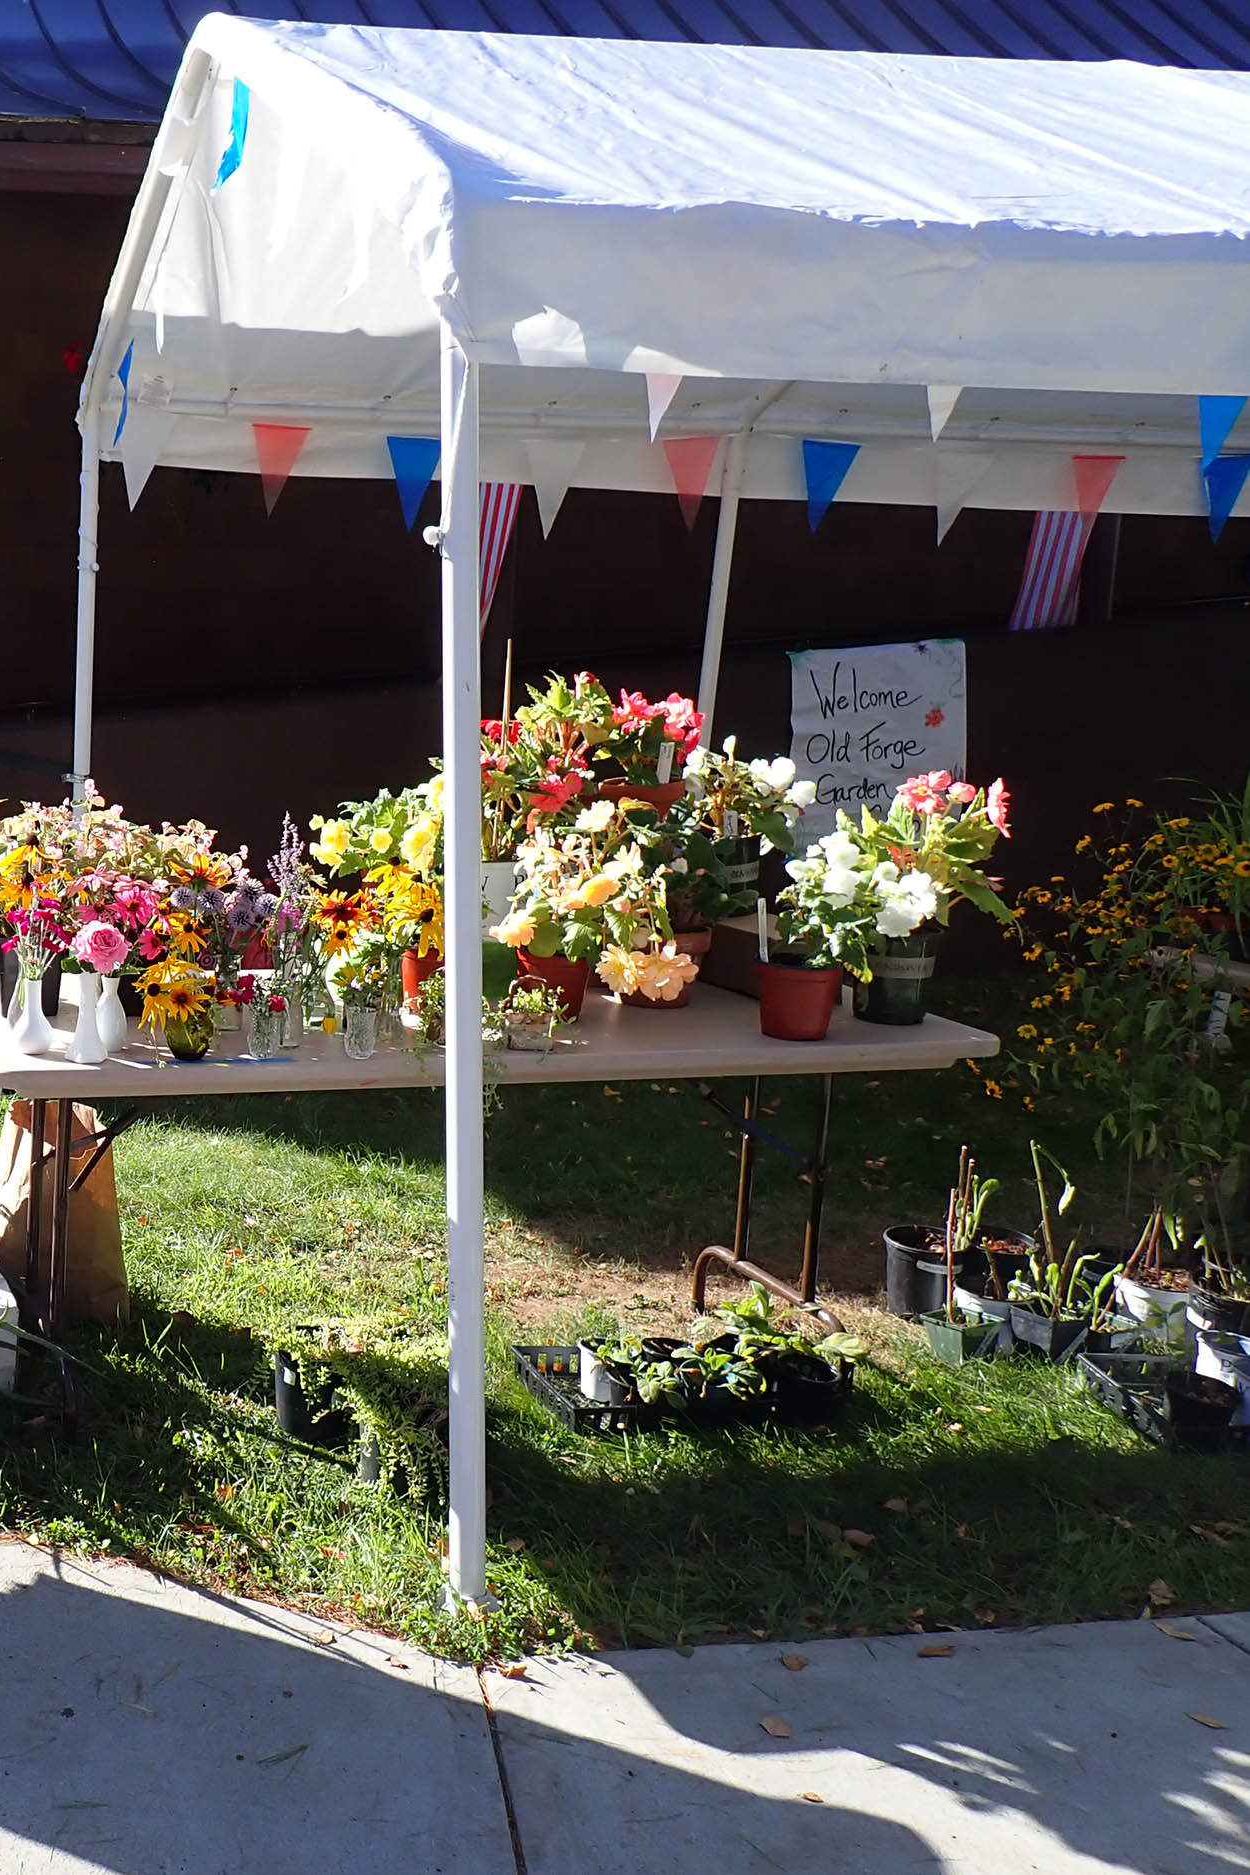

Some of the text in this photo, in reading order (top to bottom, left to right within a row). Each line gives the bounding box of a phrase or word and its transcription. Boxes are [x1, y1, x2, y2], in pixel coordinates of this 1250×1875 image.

[810, 662, 923, 719] Welcome
[806, 721, 926, 769] Old Forge
[815, 773, 895, 806] Garden
